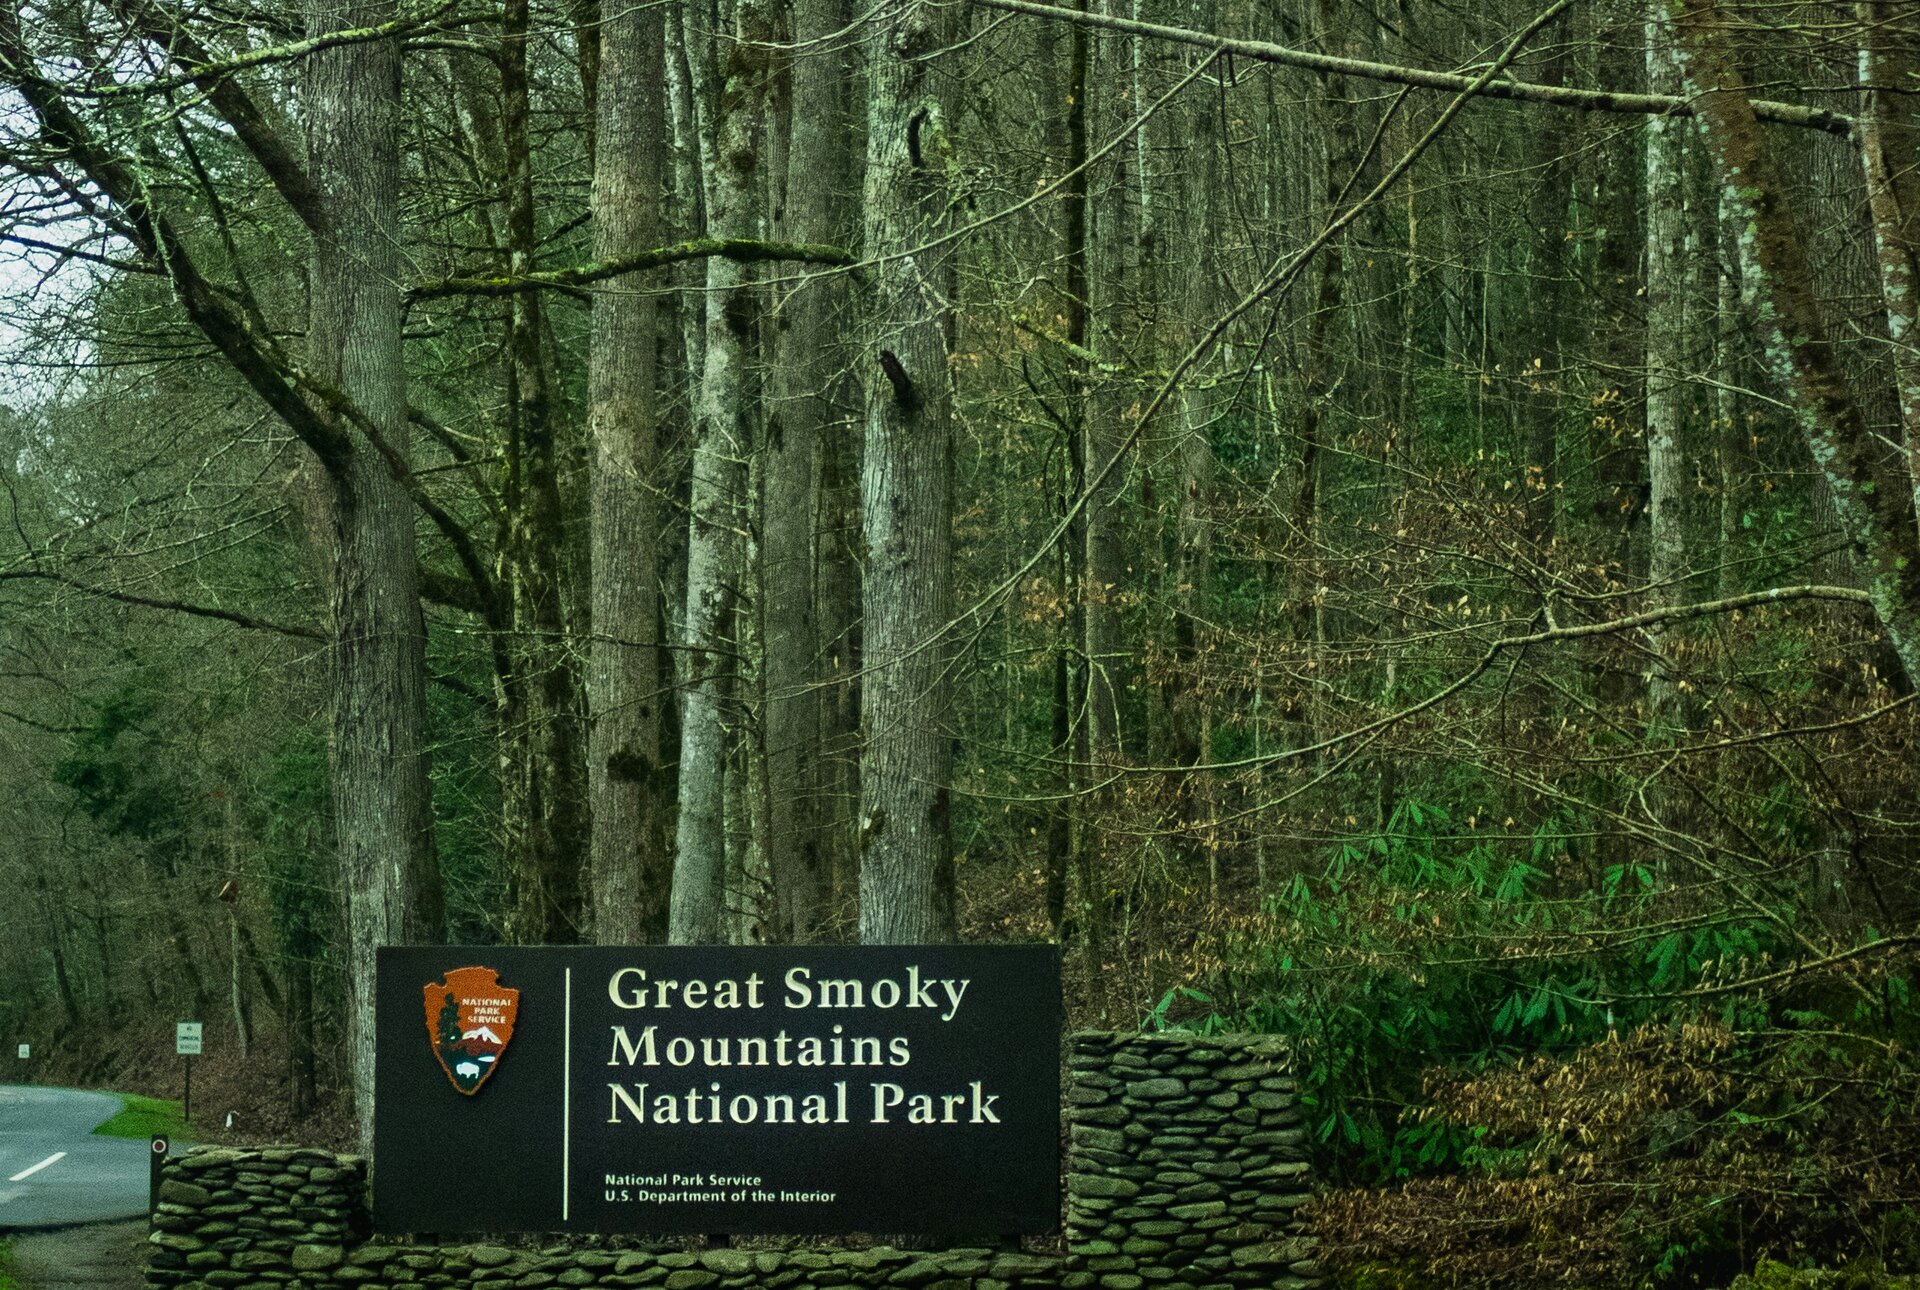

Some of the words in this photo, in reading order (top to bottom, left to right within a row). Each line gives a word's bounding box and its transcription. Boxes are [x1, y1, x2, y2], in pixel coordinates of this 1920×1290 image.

[607, 967, 765, 1010] Great
[784, 964, 971, 1022] Smoky
[474, 1007, 500, 1015] PARK
[467, 1016, 506, 1024] SERVICE
[606, 1024, 911, 1067] Mountains
[606, 1080, 849, 1125] National
[869, 1080, 1001, 1125] Park
[605, 1173, 667, 1186] National
[672, 1173, 704, 1186] Park
[709, 1173, 762, 1187] Service
[604, 1189, 633, 1202] U.S.
[638, 1189, 726, 1205] Department
[730, 1189, 747, 1202] of
[750, 1189, 776, 1202] the
[780, 1190, 837, 1203] Interior
